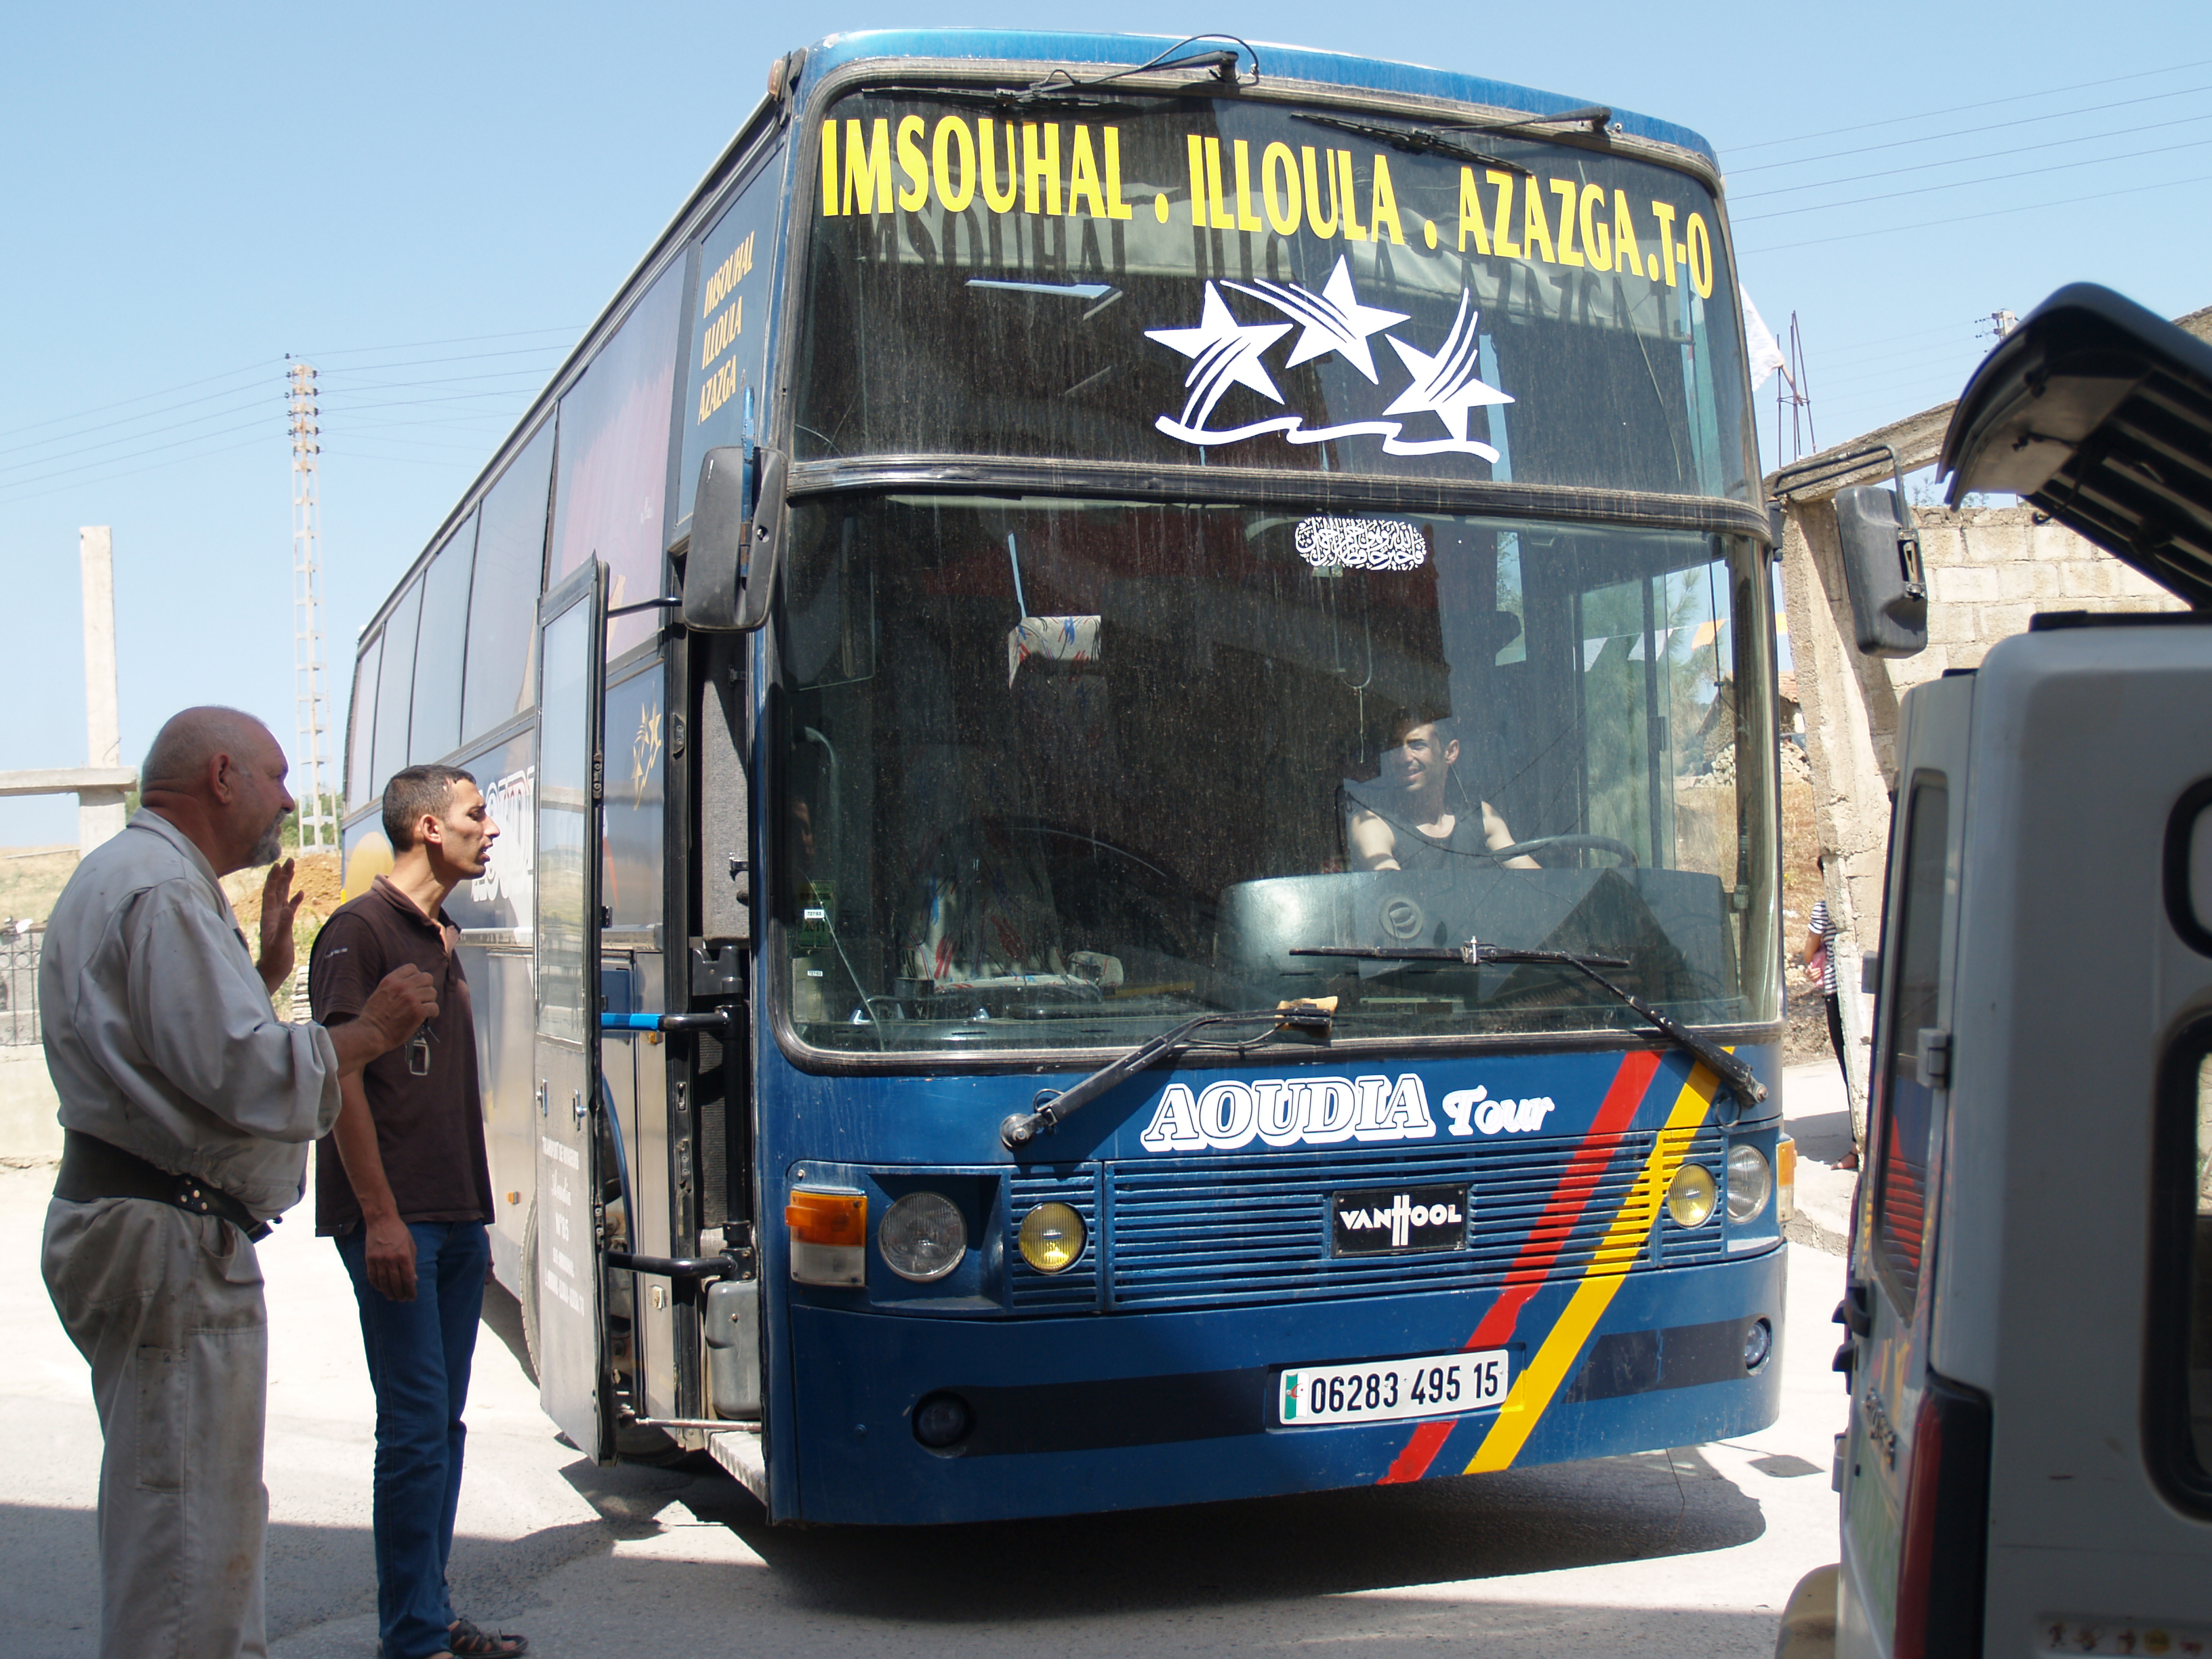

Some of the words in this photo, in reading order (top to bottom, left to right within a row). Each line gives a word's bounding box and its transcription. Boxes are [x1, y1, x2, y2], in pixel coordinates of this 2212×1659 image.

[822, 115, 1132, 220] IMSOUHAL
[1187, 134, 1405, 245] ILLOULA
[703, 230, 754, 319] IMSOUHAL
[701, 295, 742, 370] ILLOULA
[697, 354, 736, 426] AZAZGA
[1141, 1073, 1436, 1152] AOUDIA
[1443, 1085, 1555, 1136] Tour
[1311, 1372, 1398, 1414] 06283
[1410, 1366, 1460, 1405] 495
[1473, 1361, 1499, 1399] 15
